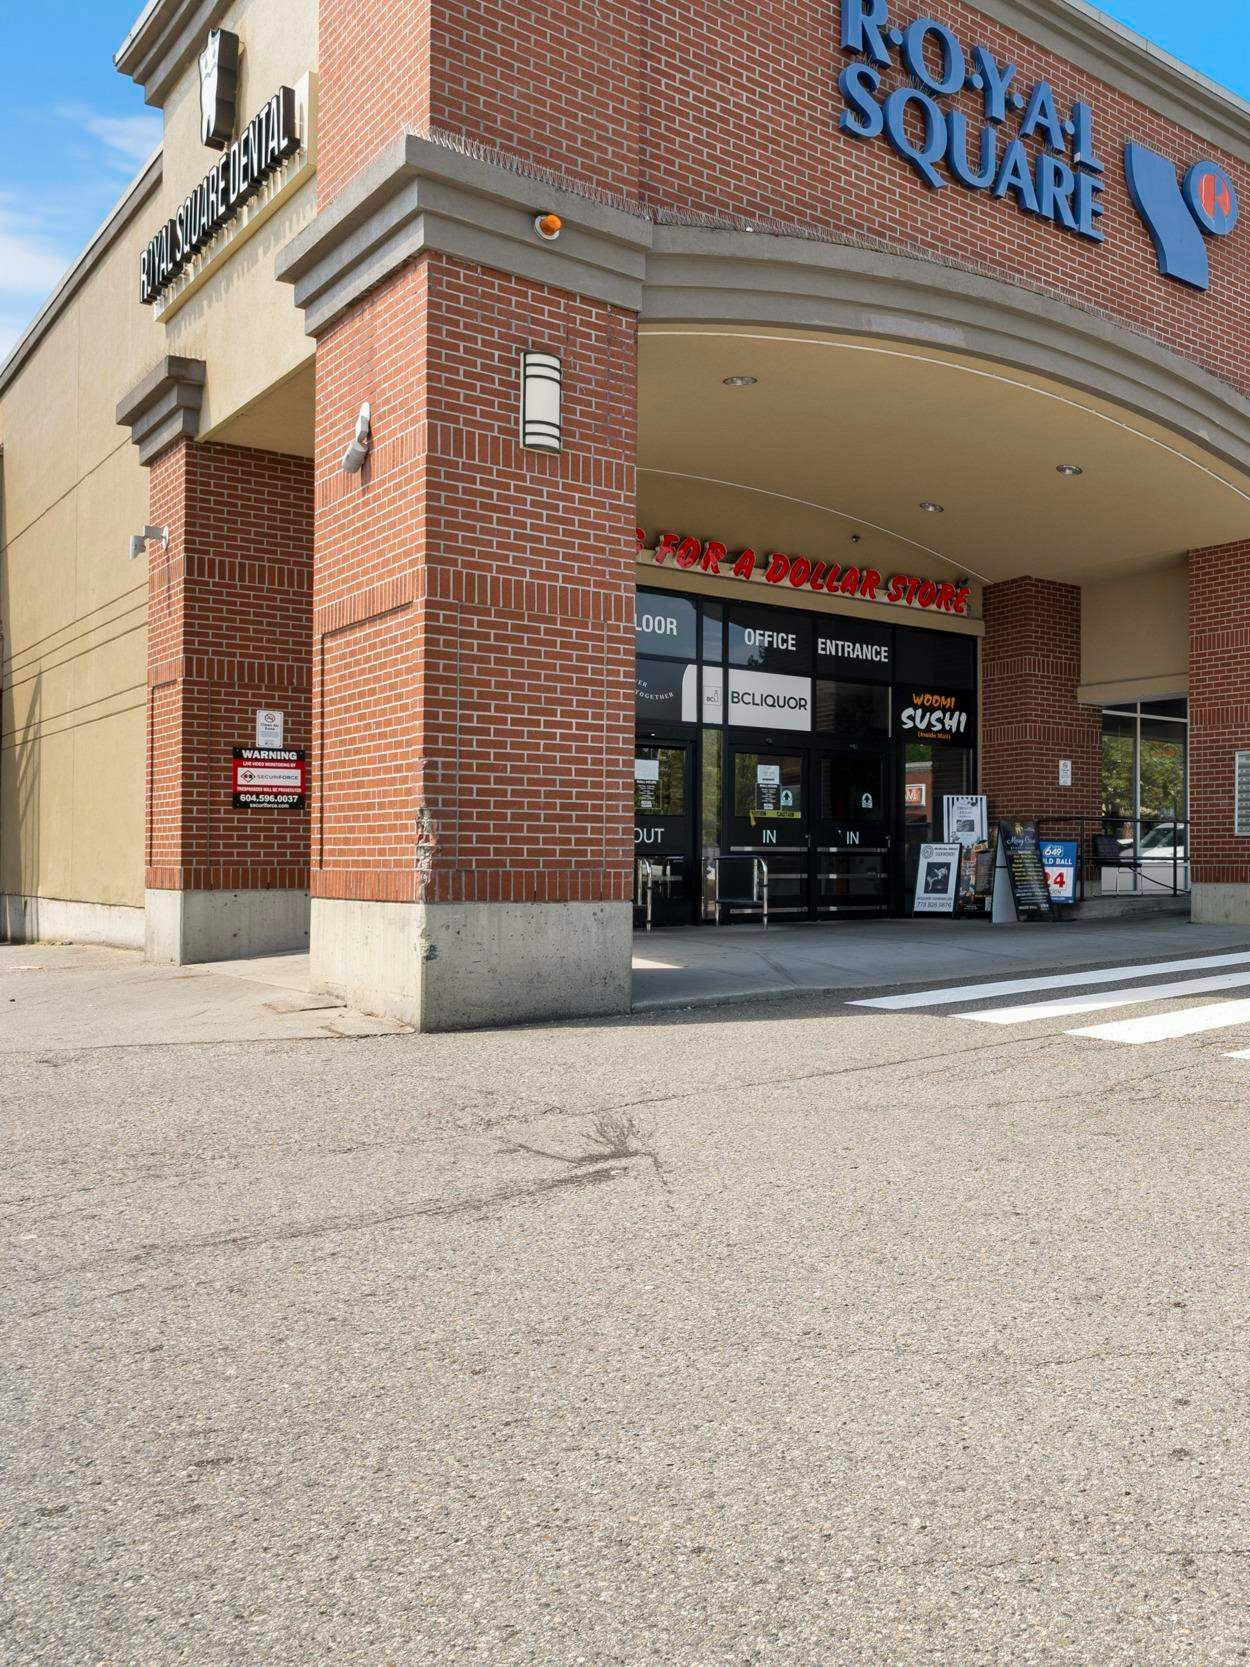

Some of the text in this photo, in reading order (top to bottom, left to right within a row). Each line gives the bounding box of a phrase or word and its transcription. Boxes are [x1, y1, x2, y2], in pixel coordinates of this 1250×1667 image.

[838, 62, 1105, 243] SQUARE
[175, 152, 231, 260] SQUARE
[228, 85, 297, 205] DENTAL
[655, 533, 727, 575] FOR
[732, 548, 757, 581] A
[763, 552, 881, 600] DOLLAR
[886, 574, 971, 615] STORE
[635, 612, 889, 662] LOOR OFFICE ENTRANCE
[731, 690, 808, 711] BCLIQUOR
[912, 693, 956, 709] WOOMI
[901, 707, 967, 734] SUSHI
[242, 749, 298, 760] WARNING
[240, 794, 299, 802] 604.596.0037
[634, 828, 664, 843] OUT
[762, 829, 776, 844] IN
[846, 831, 860, 844] IN
